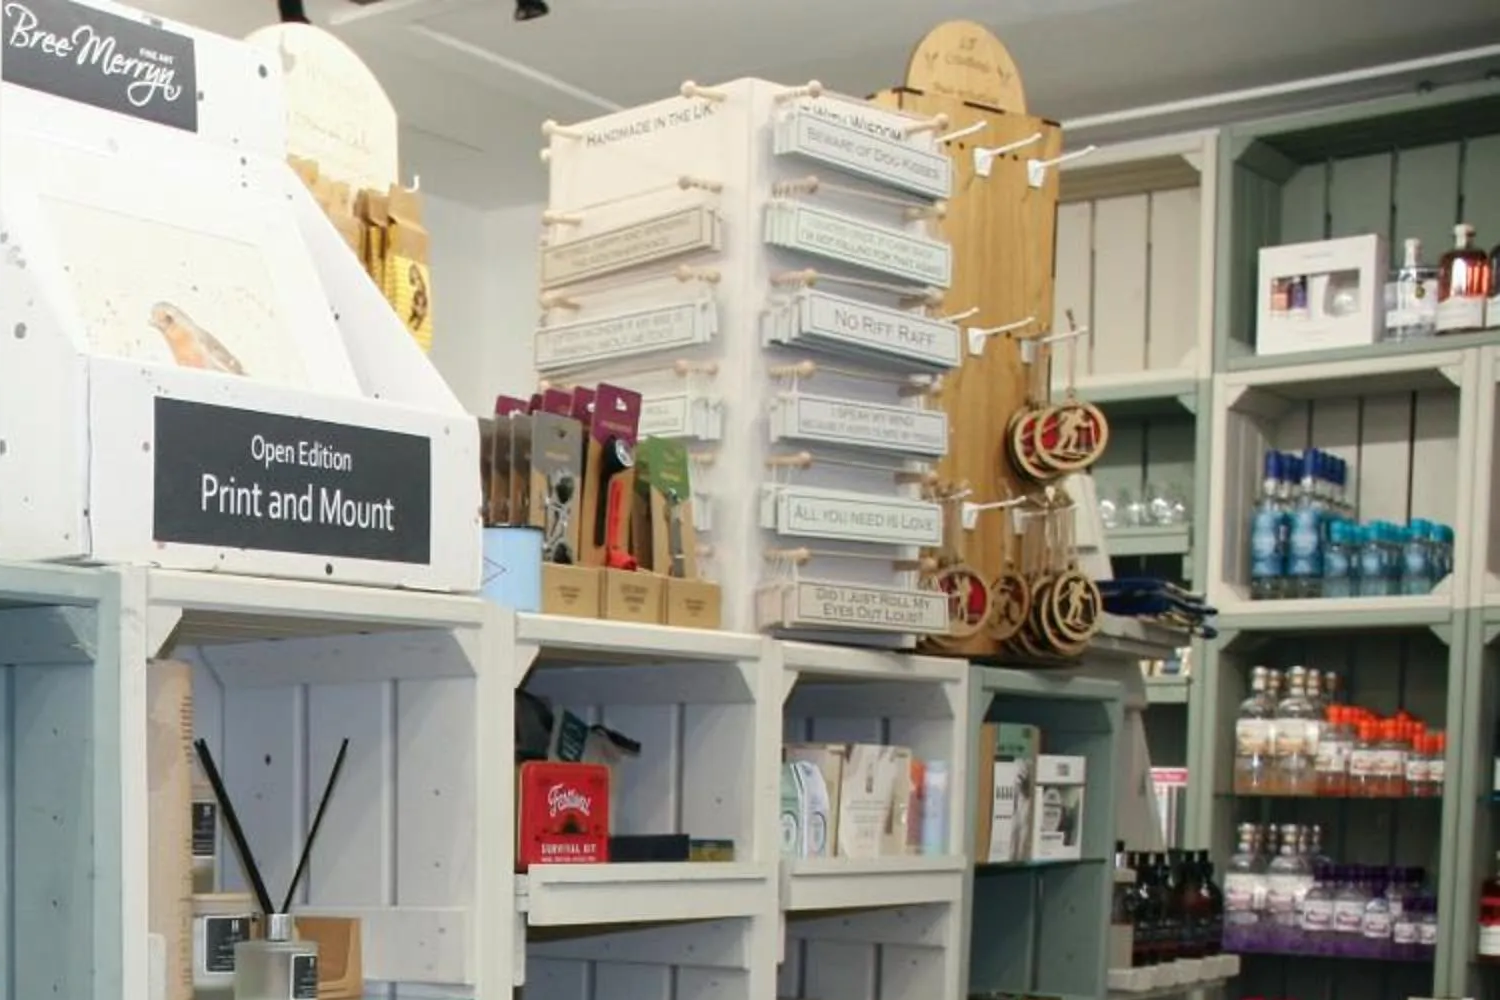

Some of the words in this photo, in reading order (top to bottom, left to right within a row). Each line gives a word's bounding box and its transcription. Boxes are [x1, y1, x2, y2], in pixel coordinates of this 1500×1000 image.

[4, 3, 73, 57] Bree
[71, 25, 182, 107] Merryn
[586, 119, 652, 147] HANDMADE
[653, 116, 667, 130] IN
[668, 108, 691, 126] THE
[693, 102, 714, 119] UK
[834, 308, 860, 331] NO
[862, 315, 896, 337] RIFF
[897, 325, 937, 346] RAFF
[251, 434, 295, 470] Open
[299, 440, 352, 472] Edition
[201, 472, 263, 517] Print
[268, 483, 313, 523] and
[320, 487, 395, 532] Mount
[794, 504, 820, 520] ALL
[822, 508, 849, 525] YOU
[850, 511, 884, 528] NEED
[886, 513, 898, 529] IS
[900, 513, 934, 531] LOVE
[816, 588, 838, 601] DID
[849, 590, 877, 605] JUST
[879, 591, 910, 607] ROLL
[913, 595, 931, 610] MY
[823, 602, 854, 617] EYES
[856, 605, 882, 619] OUT
[541, 843, 581, 854] SURVIVAL
